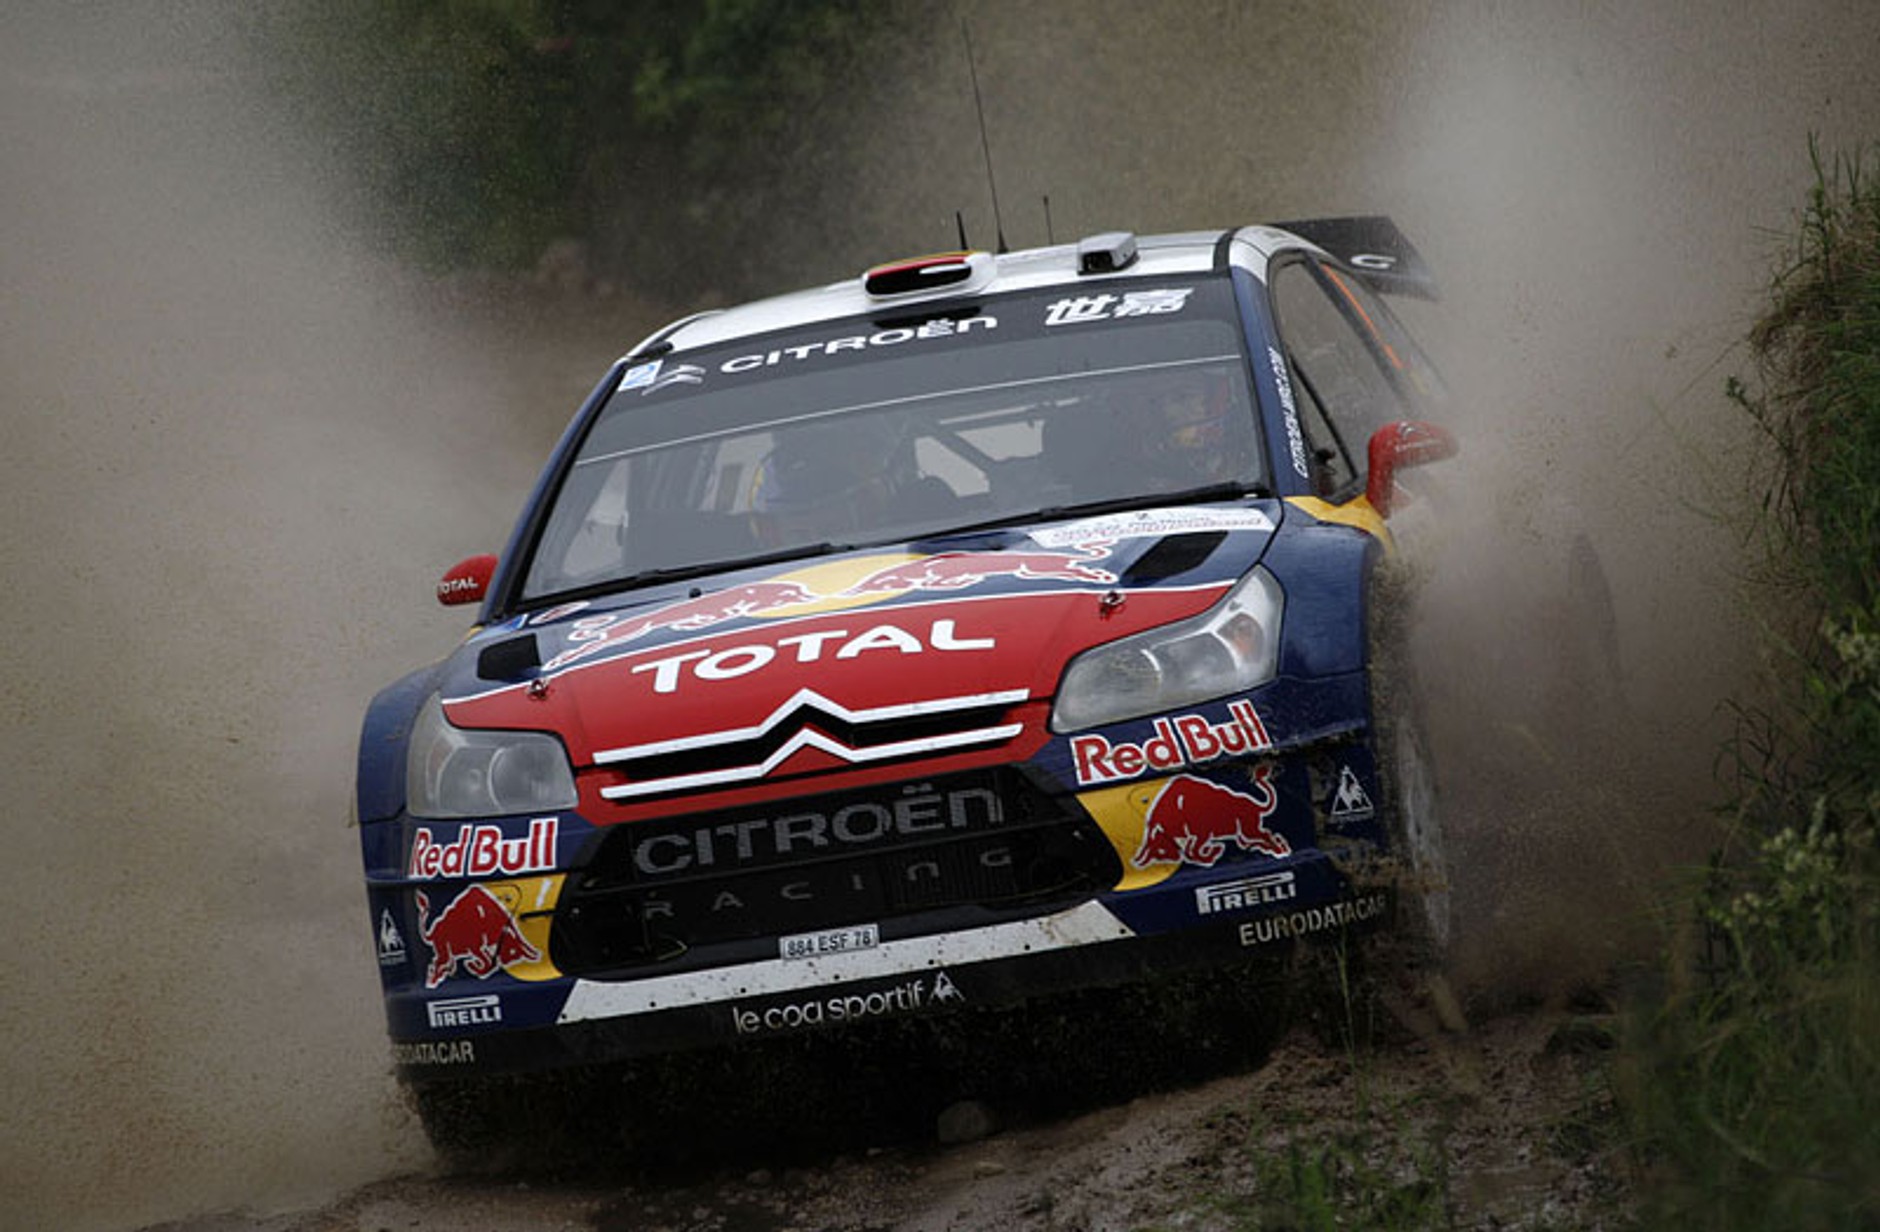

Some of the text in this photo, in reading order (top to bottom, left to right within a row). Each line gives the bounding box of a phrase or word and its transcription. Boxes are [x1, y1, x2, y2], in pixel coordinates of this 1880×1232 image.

[631, 618, 996, 694] TOTAL
[1070, 699, 1272, 785] Red Bull
[408, 817, 559, 879] Red Bull
[1196, 871, 1297, 914] PIRELLI
[818, 934, 850, 953] ESF
[427, 995, 501, 1027] PIRELLI
[733, 1006, 762, 1035] le
[827, 979, 926, 1022] sportif
